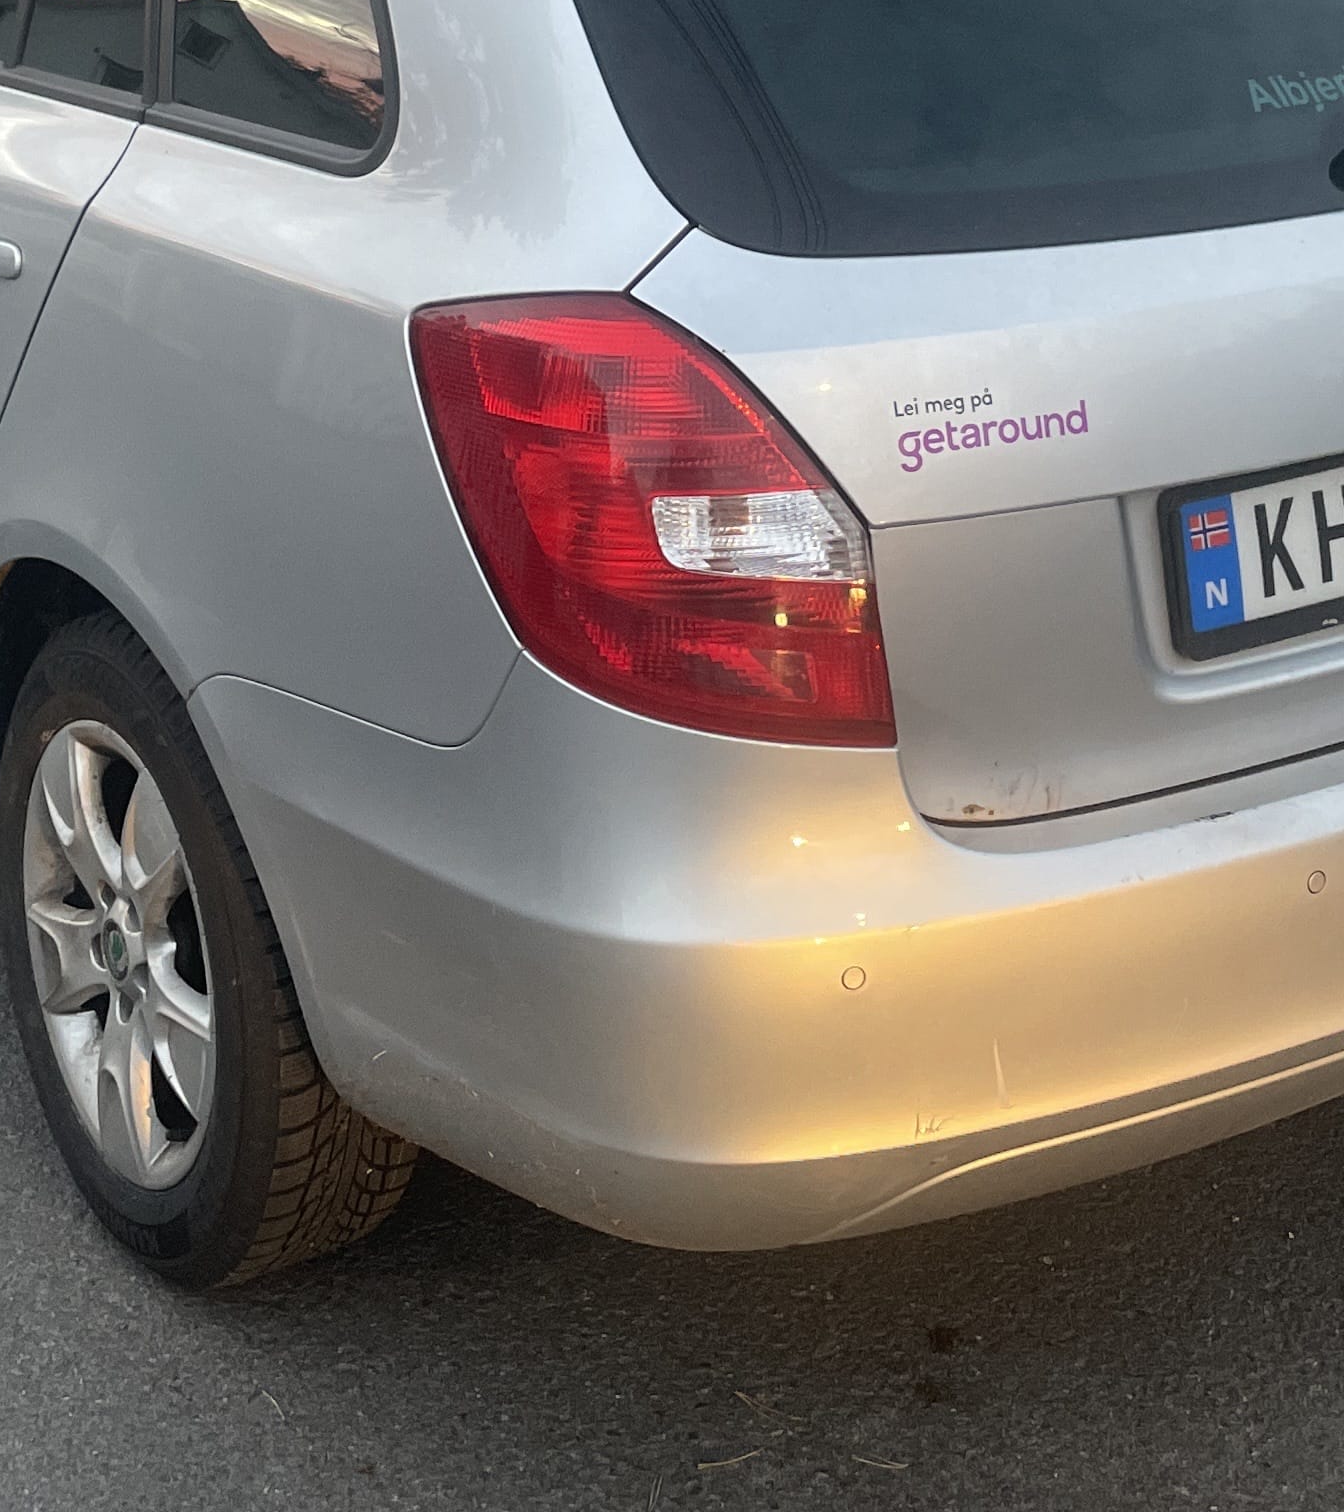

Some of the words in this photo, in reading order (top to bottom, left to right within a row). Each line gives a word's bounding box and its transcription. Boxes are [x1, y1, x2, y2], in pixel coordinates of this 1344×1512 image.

[893, 397, 919, 418] Lei
[924, 396, 965, 415] meg
[969, 387, 994, 413] på
[897, 399, 1089, 473] getaround
[1203, 577, 1230, 610] N
